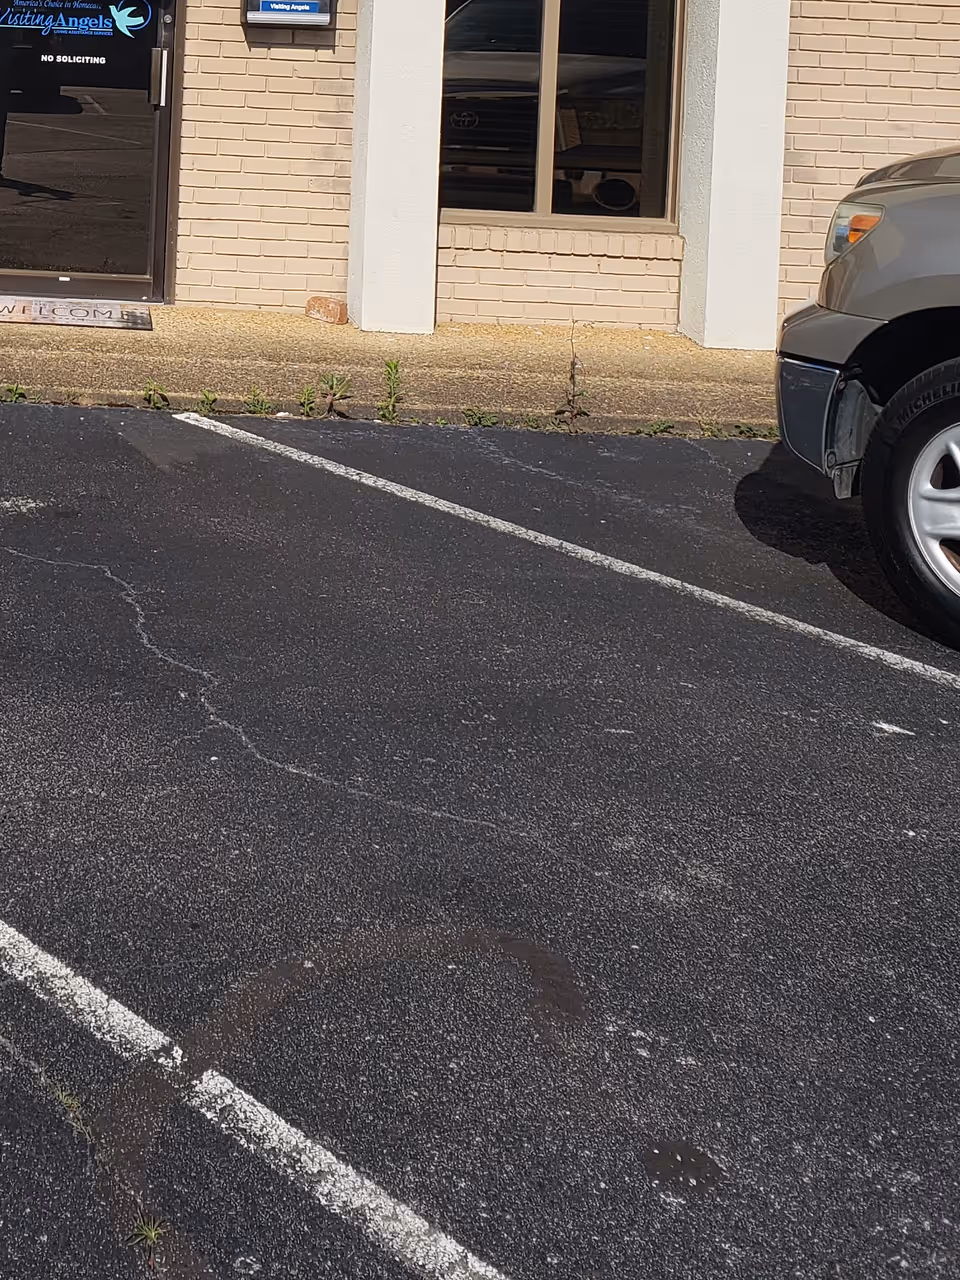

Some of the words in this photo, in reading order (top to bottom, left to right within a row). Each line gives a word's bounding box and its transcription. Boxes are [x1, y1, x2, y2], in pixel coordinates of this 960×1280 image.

[64, 0, 71, 8] in
[270, 3, 290, 11] Visiting
[54, 12, 113, 31] Angels
[41, 54, 54, 62] NO
[56, 55, 106, 64] SOLICITING
